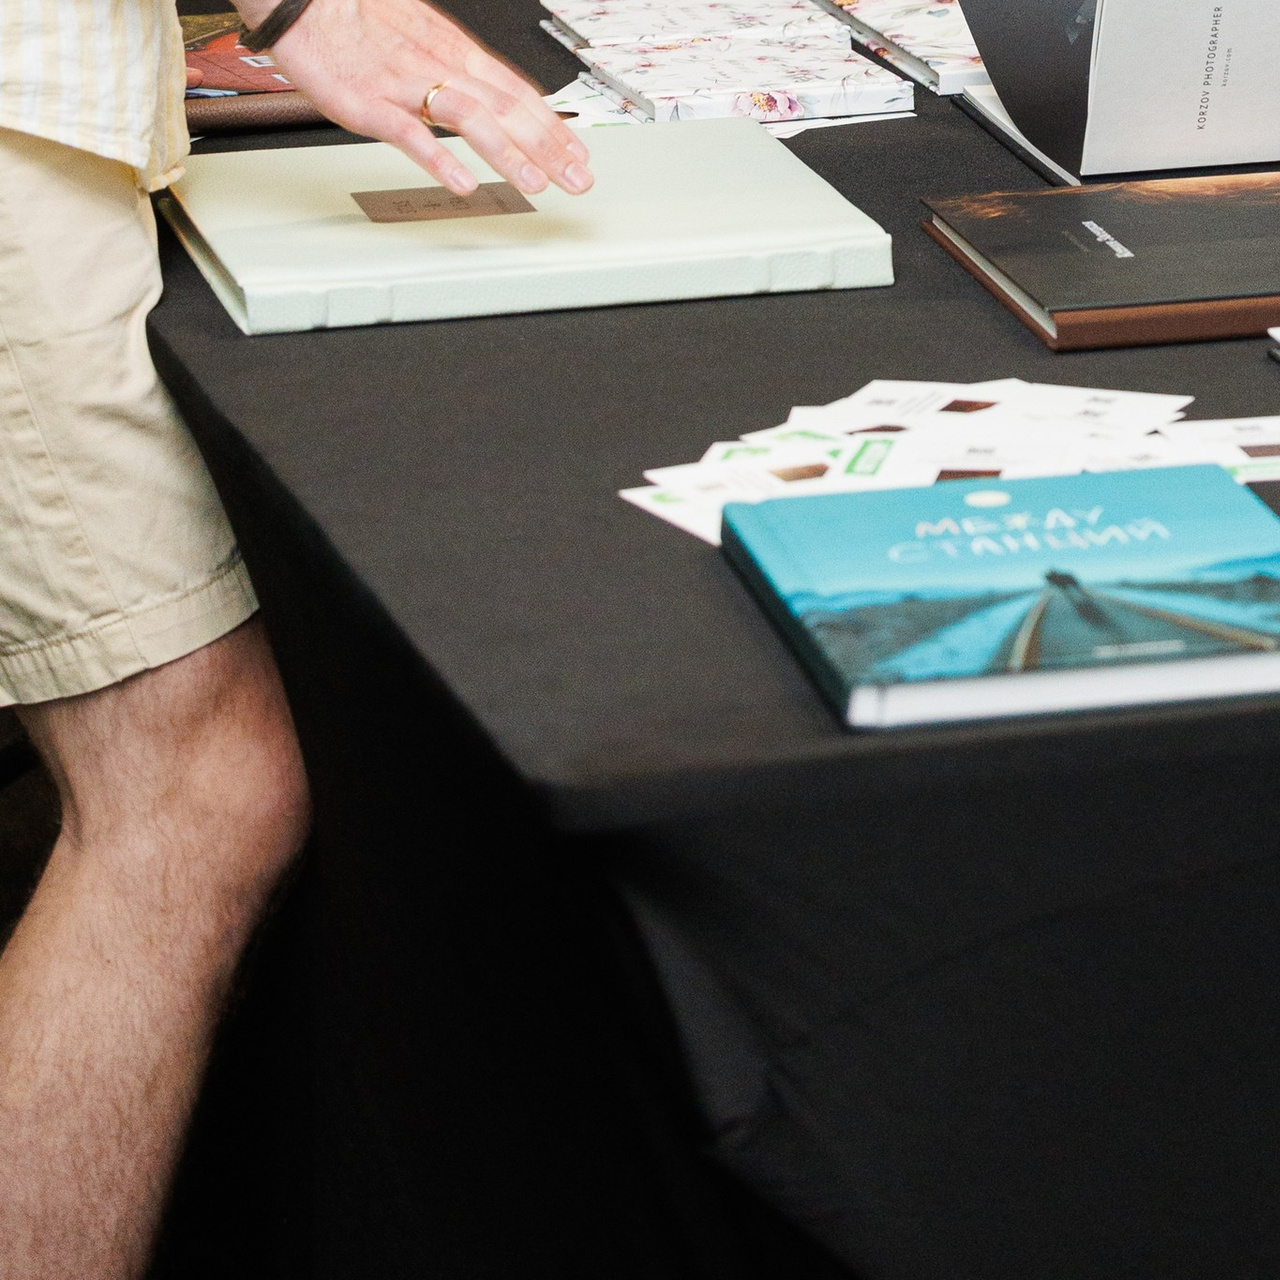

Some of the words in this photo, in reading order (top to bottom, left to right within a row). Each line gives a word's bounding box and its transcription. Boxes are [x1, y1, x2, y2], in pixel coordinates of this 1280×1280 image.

[1203, 6, 1223, 86] PHOTOGRAPHER
[1221, 47, 1233, 87] korzov.com
[1197, 90, 1210, 130] KORZOV
[887, 516, 1172, 565] СТАНЦИЙ
[914, 504, 1104, 539] МЕЖДУ
